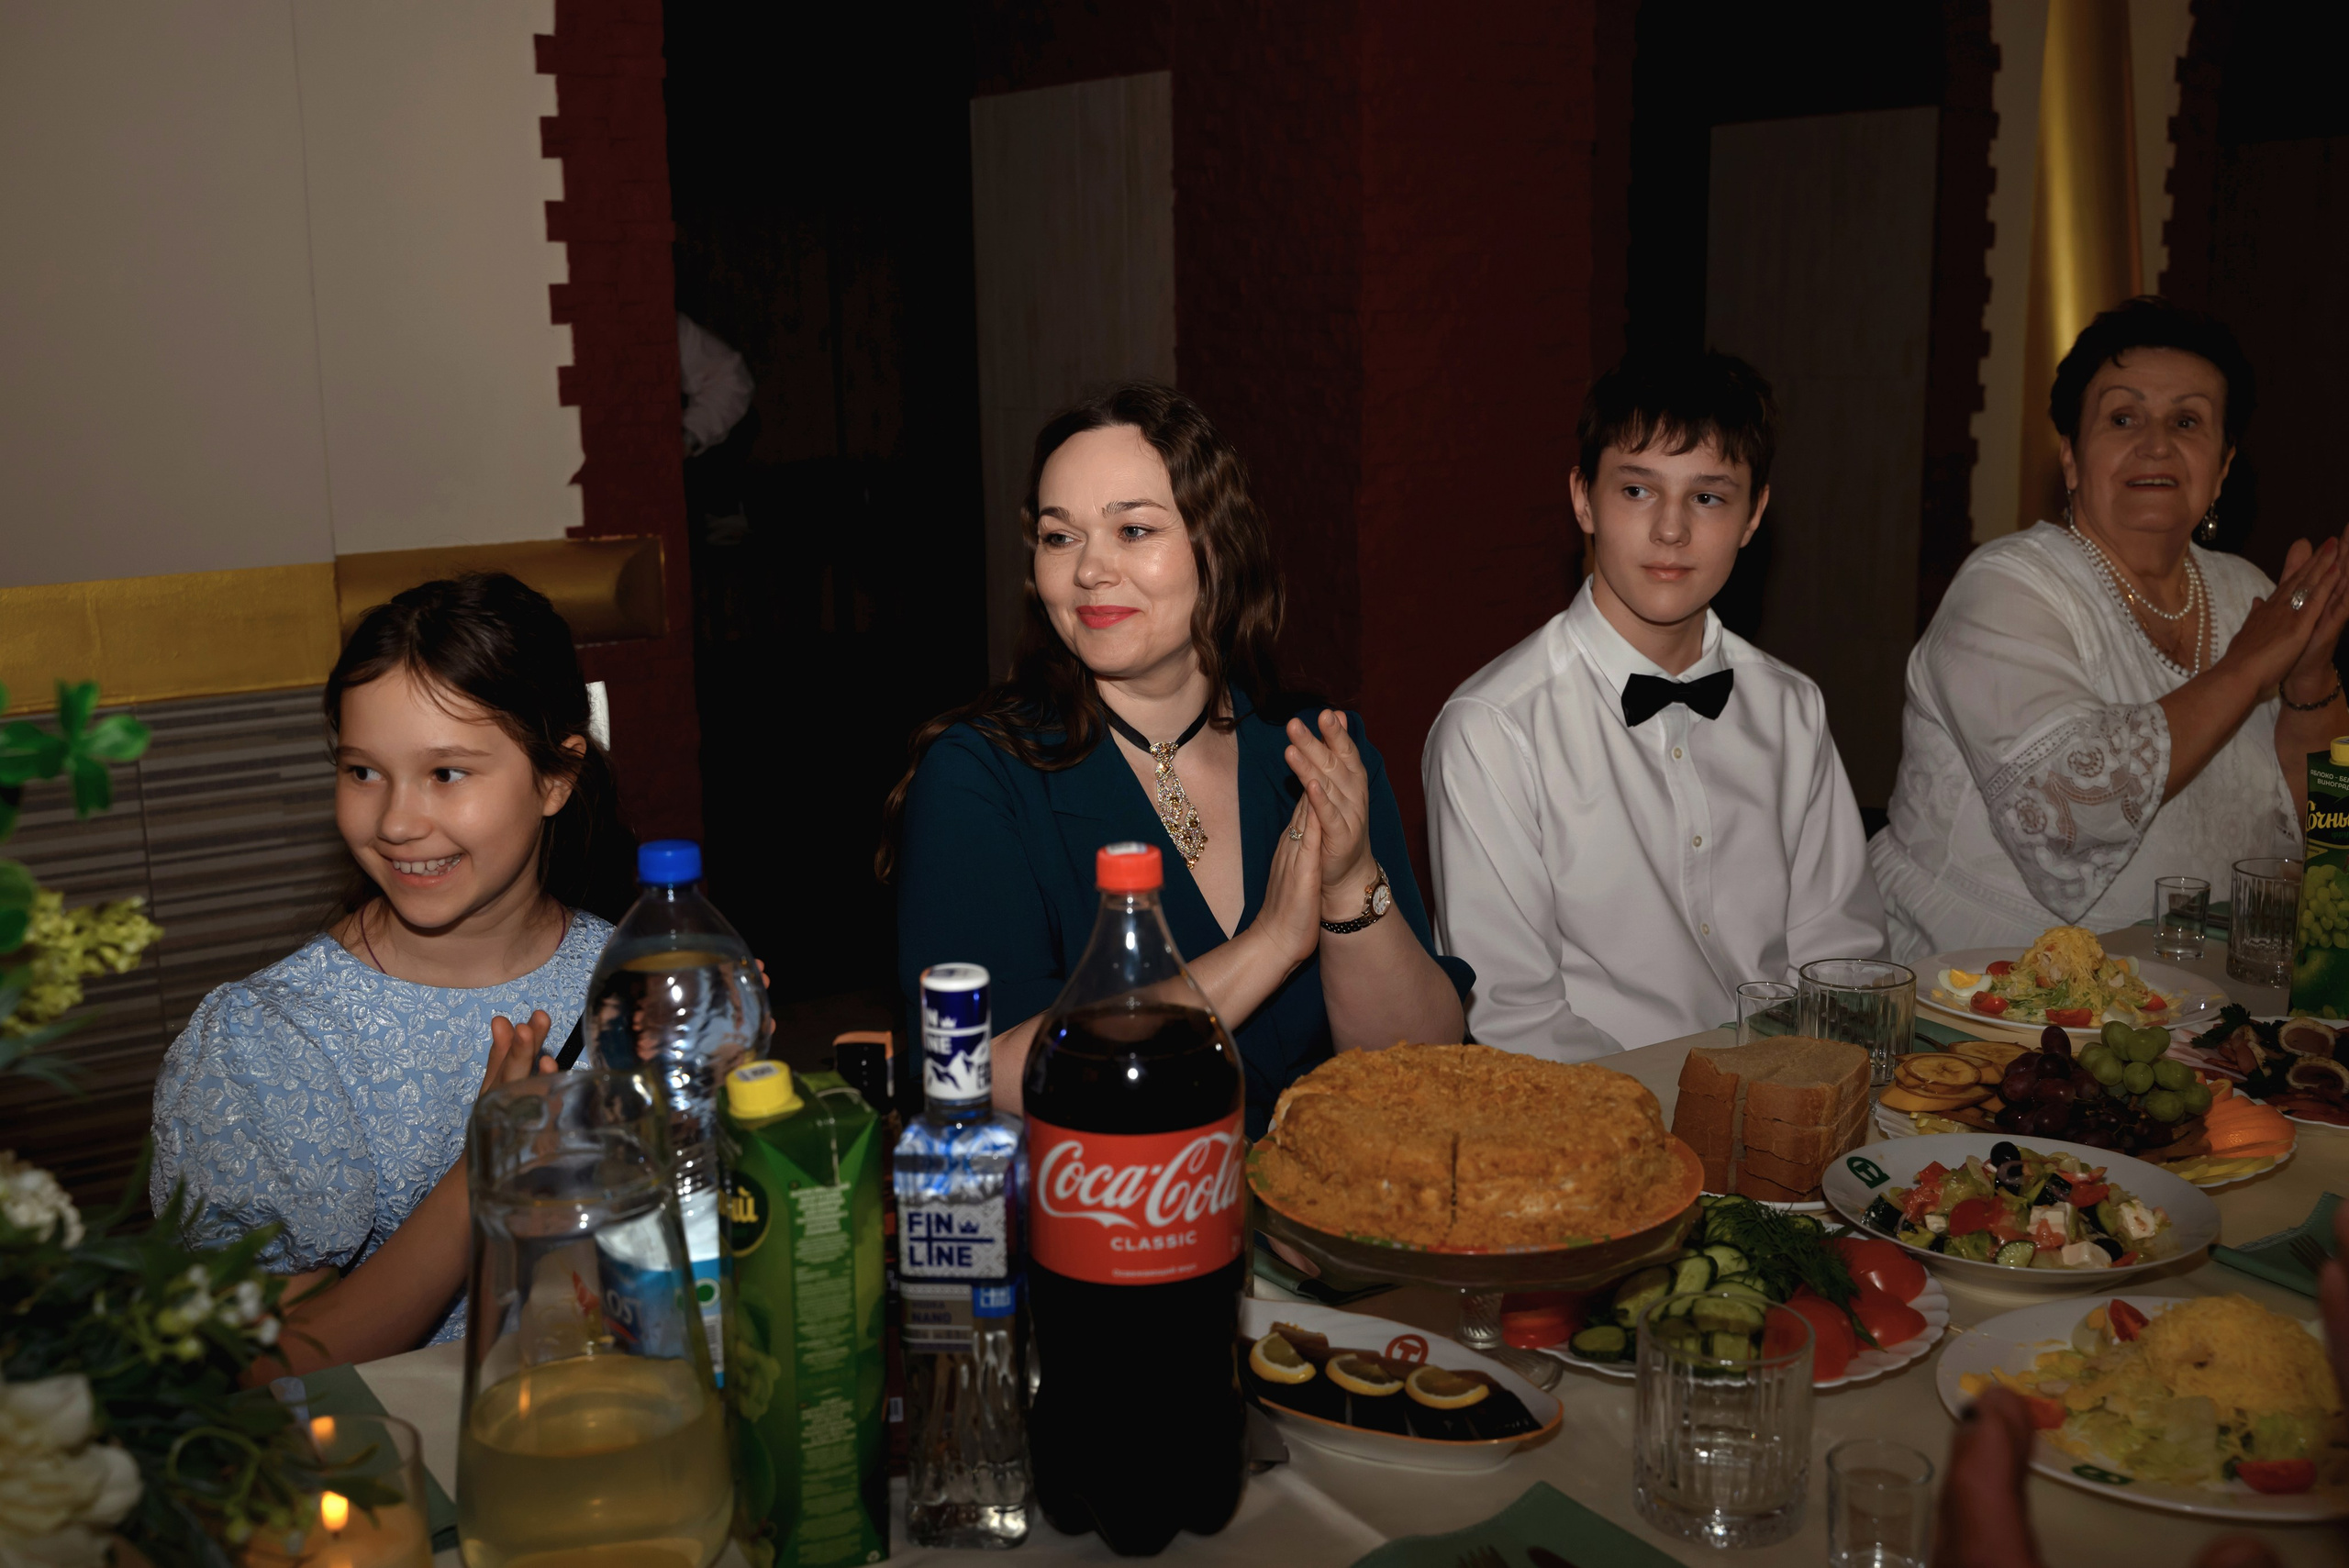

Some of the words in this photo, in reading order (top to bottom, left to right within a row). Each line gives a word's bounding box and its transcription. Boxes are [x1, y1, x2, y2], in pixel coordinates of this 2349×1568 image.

[2310, 769, 2333, 780] ЯБЛОКО
[1037, 1130, 1243, 1229] Coca-Cola
[907, 1211, 954, 1236] FIN
[1110, 1229, 1197, 1251] CLASSIC
[908, 1245, 974, 1268] LINE
